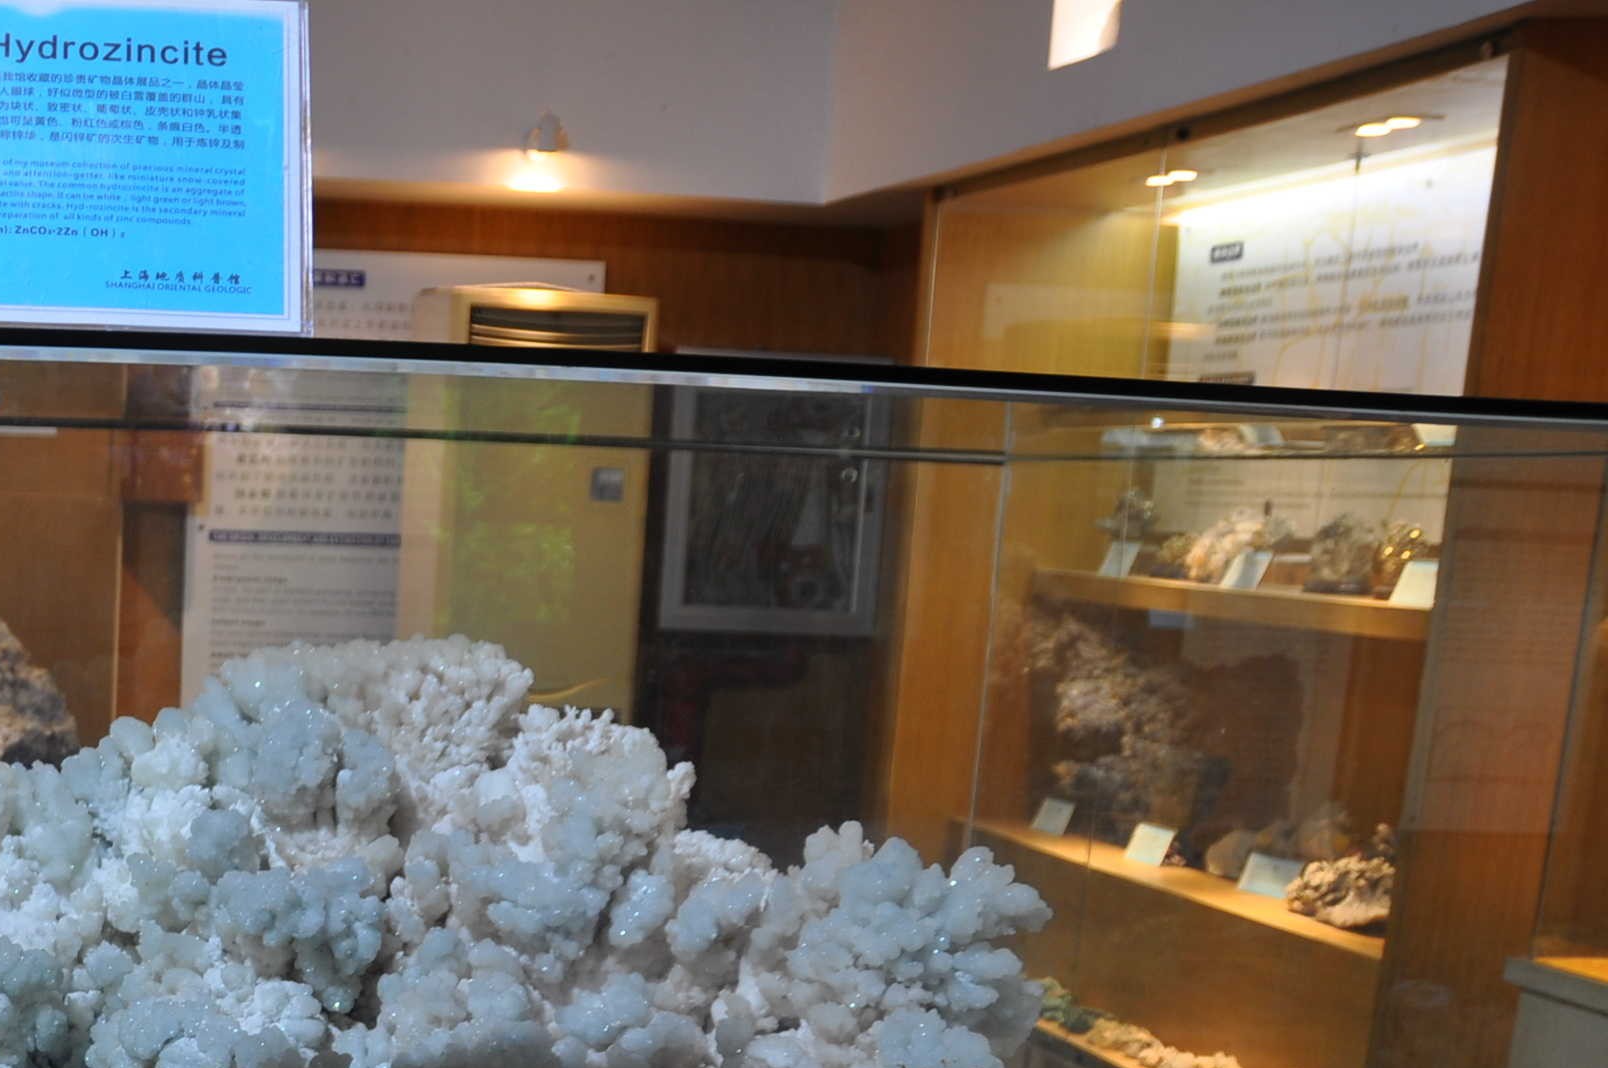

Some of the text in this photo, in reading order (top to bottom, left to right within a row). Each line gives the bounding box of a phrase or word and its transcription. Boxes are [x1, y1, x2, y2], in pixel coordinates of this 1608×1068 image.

[215, 166, 245, 176] crystal
[186, 186, 232, 196] aggregate
[141, 205, 157, 213] the
[104, 280, 253, 295] SHANGHAI ORIENTAL GEOLOGIC
